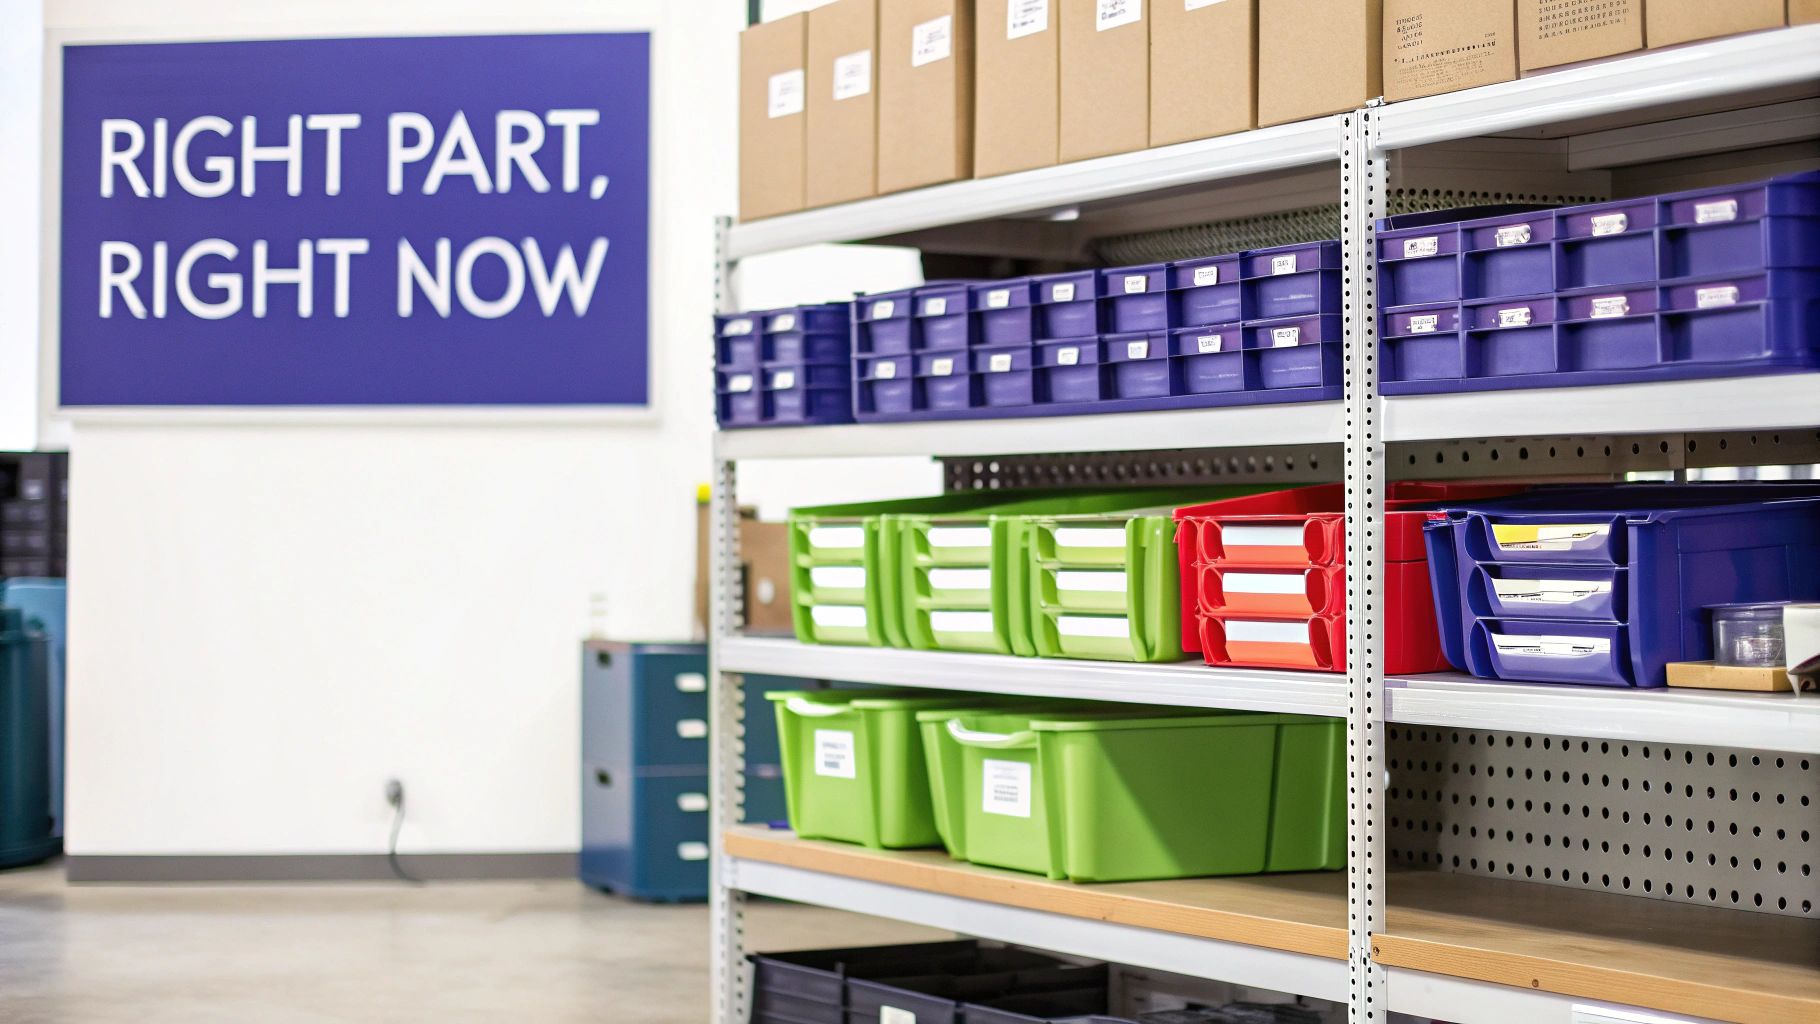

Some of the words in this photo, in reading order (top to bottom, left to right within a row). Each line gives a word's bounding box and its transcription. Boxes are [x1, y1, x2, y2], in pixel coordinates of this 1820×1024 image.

[100, 113, 362, 198] RIGHT
[388, 110, 609, 200] PART,
[99, 238, 370, 319] RIGHT
[397, 236, 609, 319] NOW
